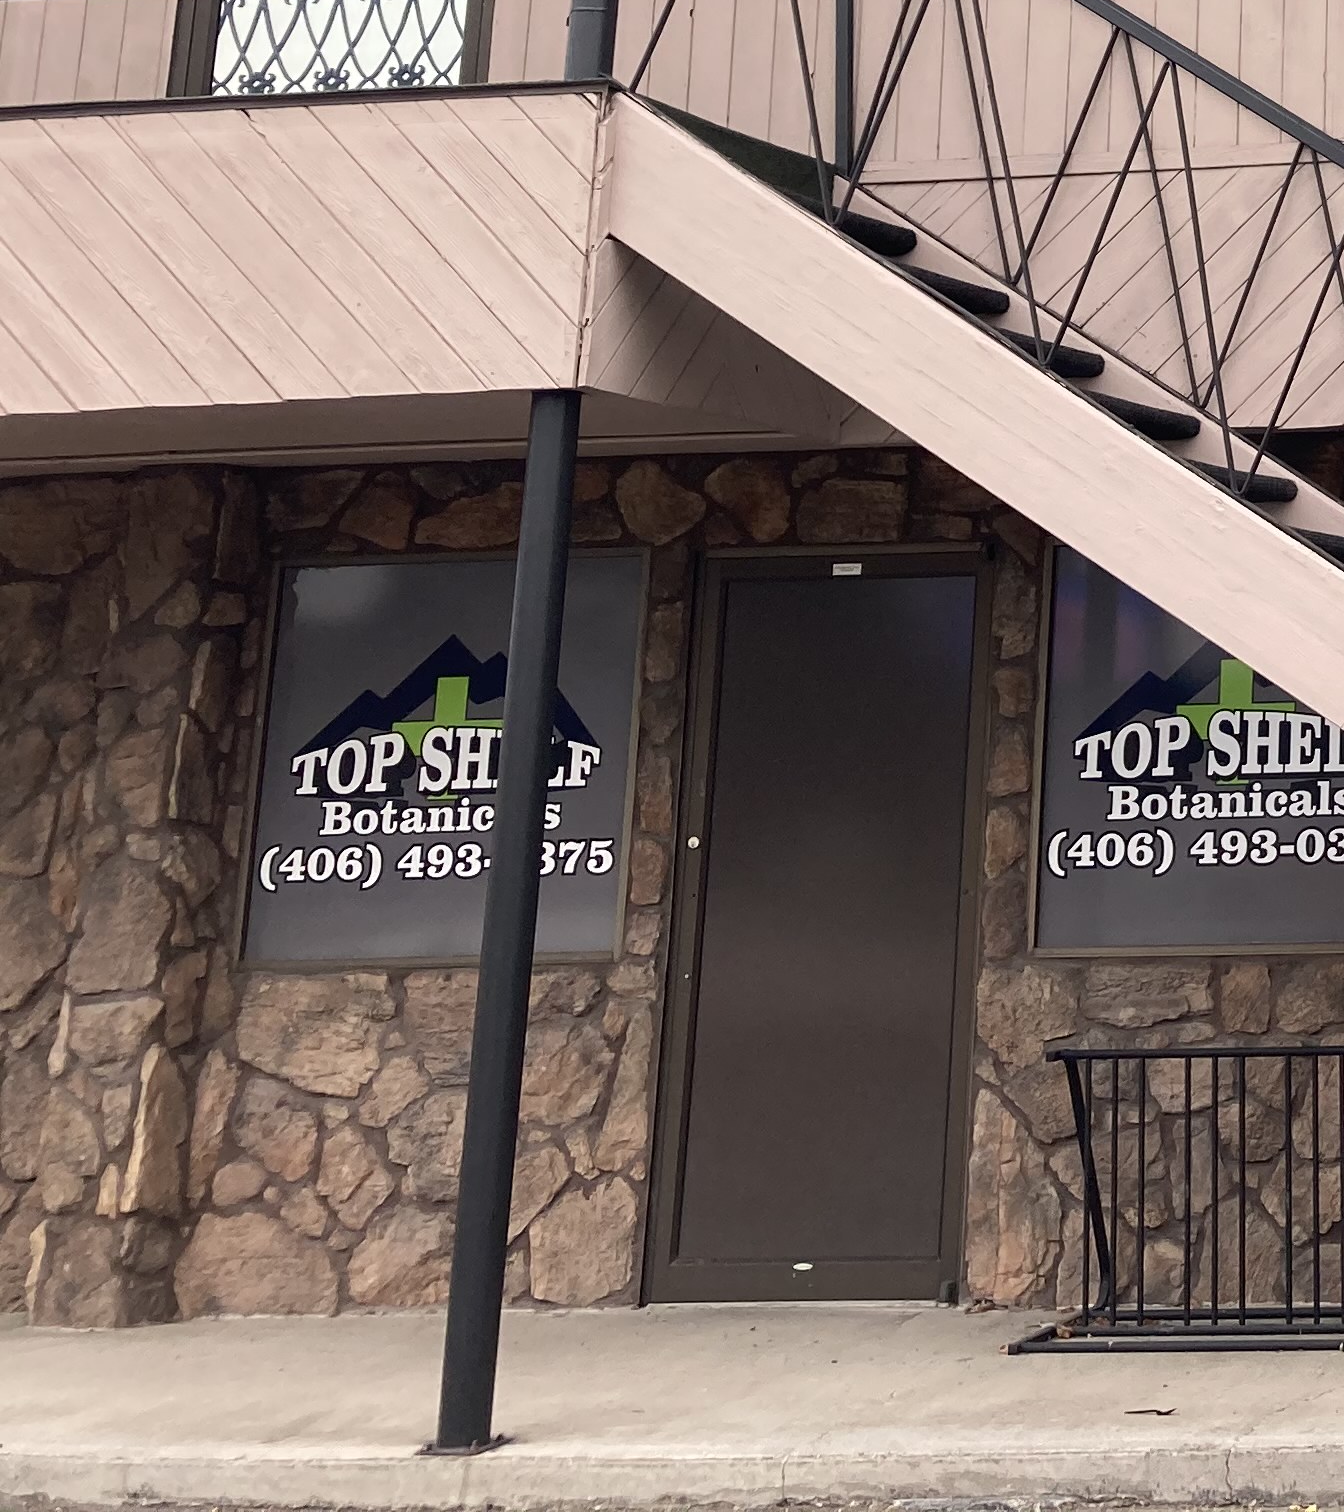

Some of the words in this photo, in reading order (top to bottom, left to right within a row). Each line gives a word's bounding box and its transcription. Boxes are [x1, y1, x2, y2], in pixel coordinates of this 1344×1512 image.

[291, 731, 405, 796] TOP
[418, 725, 601, 793] SHF
[1073, 715, 1192, 781] TOP
[318, 796, 562, 837] Botanics
[259, 843, 384, 891] (406)
[396, 838, 614, 880] 493-375
[1047, 828, 1175, 878] (406)
